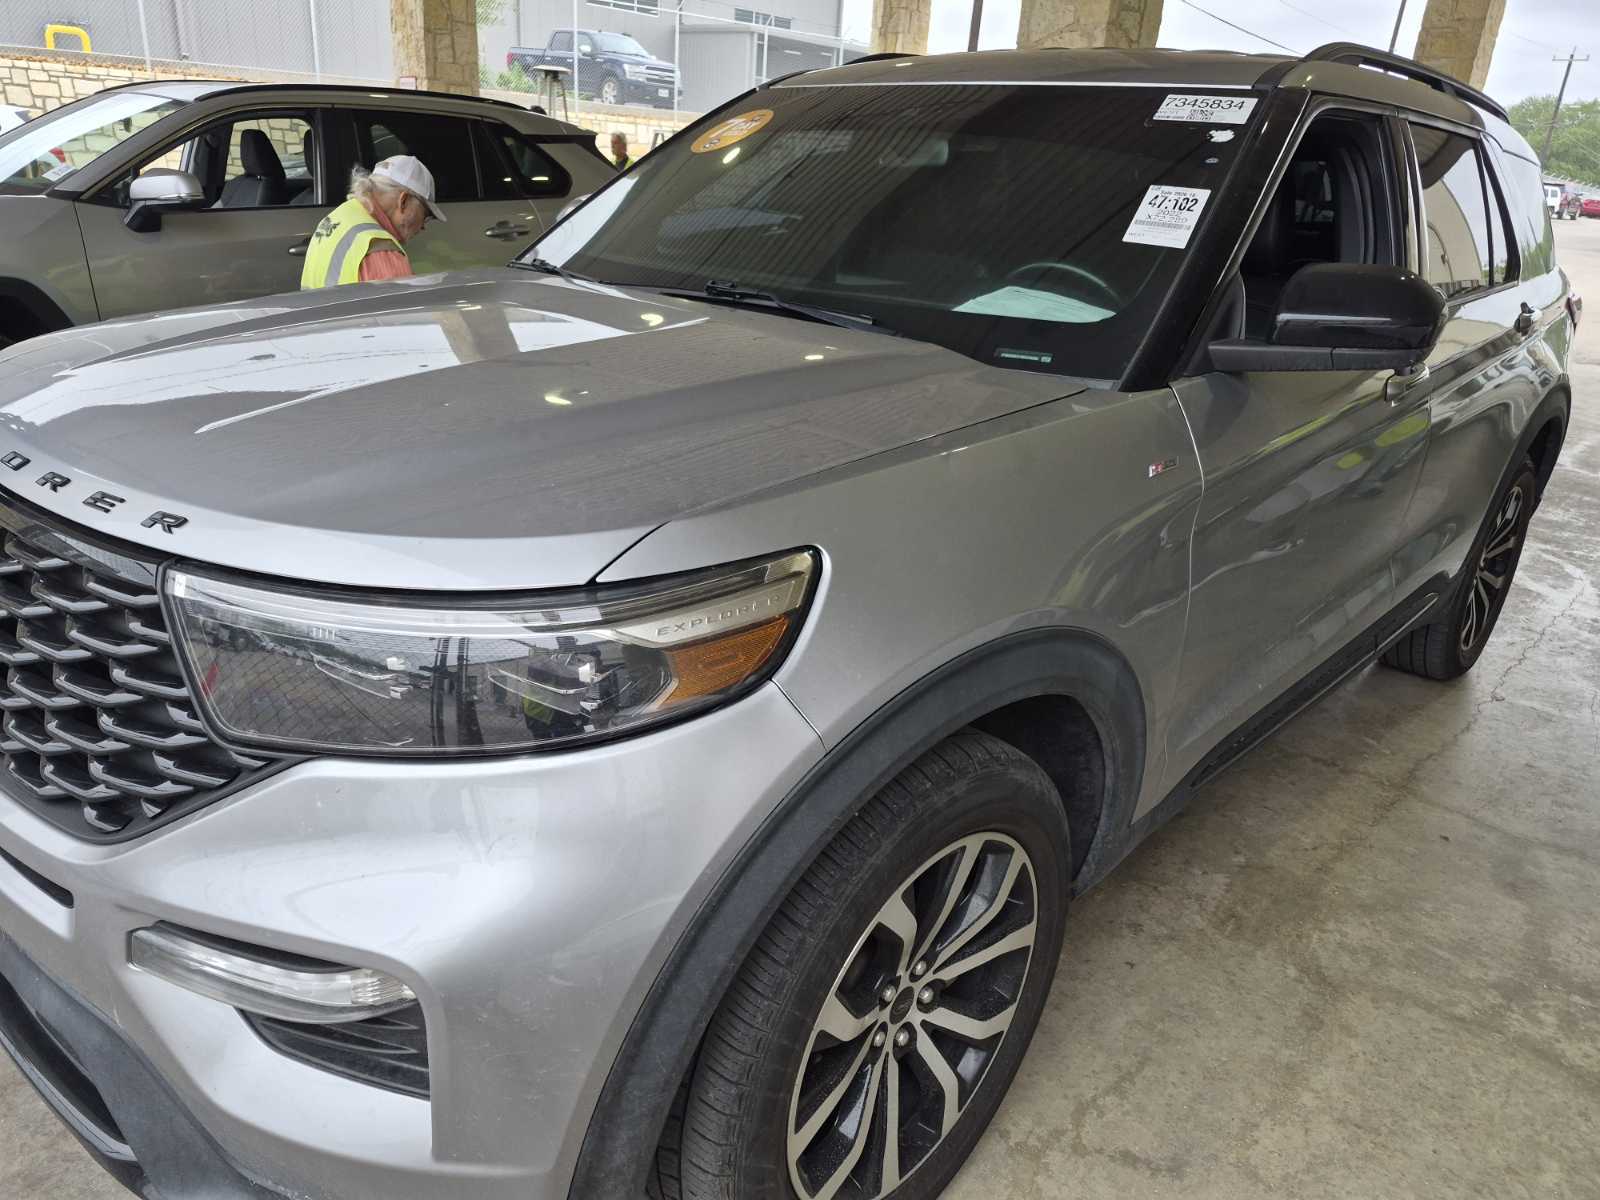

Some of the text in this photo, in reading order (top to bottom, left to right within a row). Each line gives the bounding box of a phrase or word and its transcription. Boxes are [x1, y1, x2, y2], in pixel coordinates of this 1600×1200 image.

[1165, 97, 1246, 111] 7345834
[1148, 194, 1199, 212] 47:102
[0, 450, 190, 535] ORER
